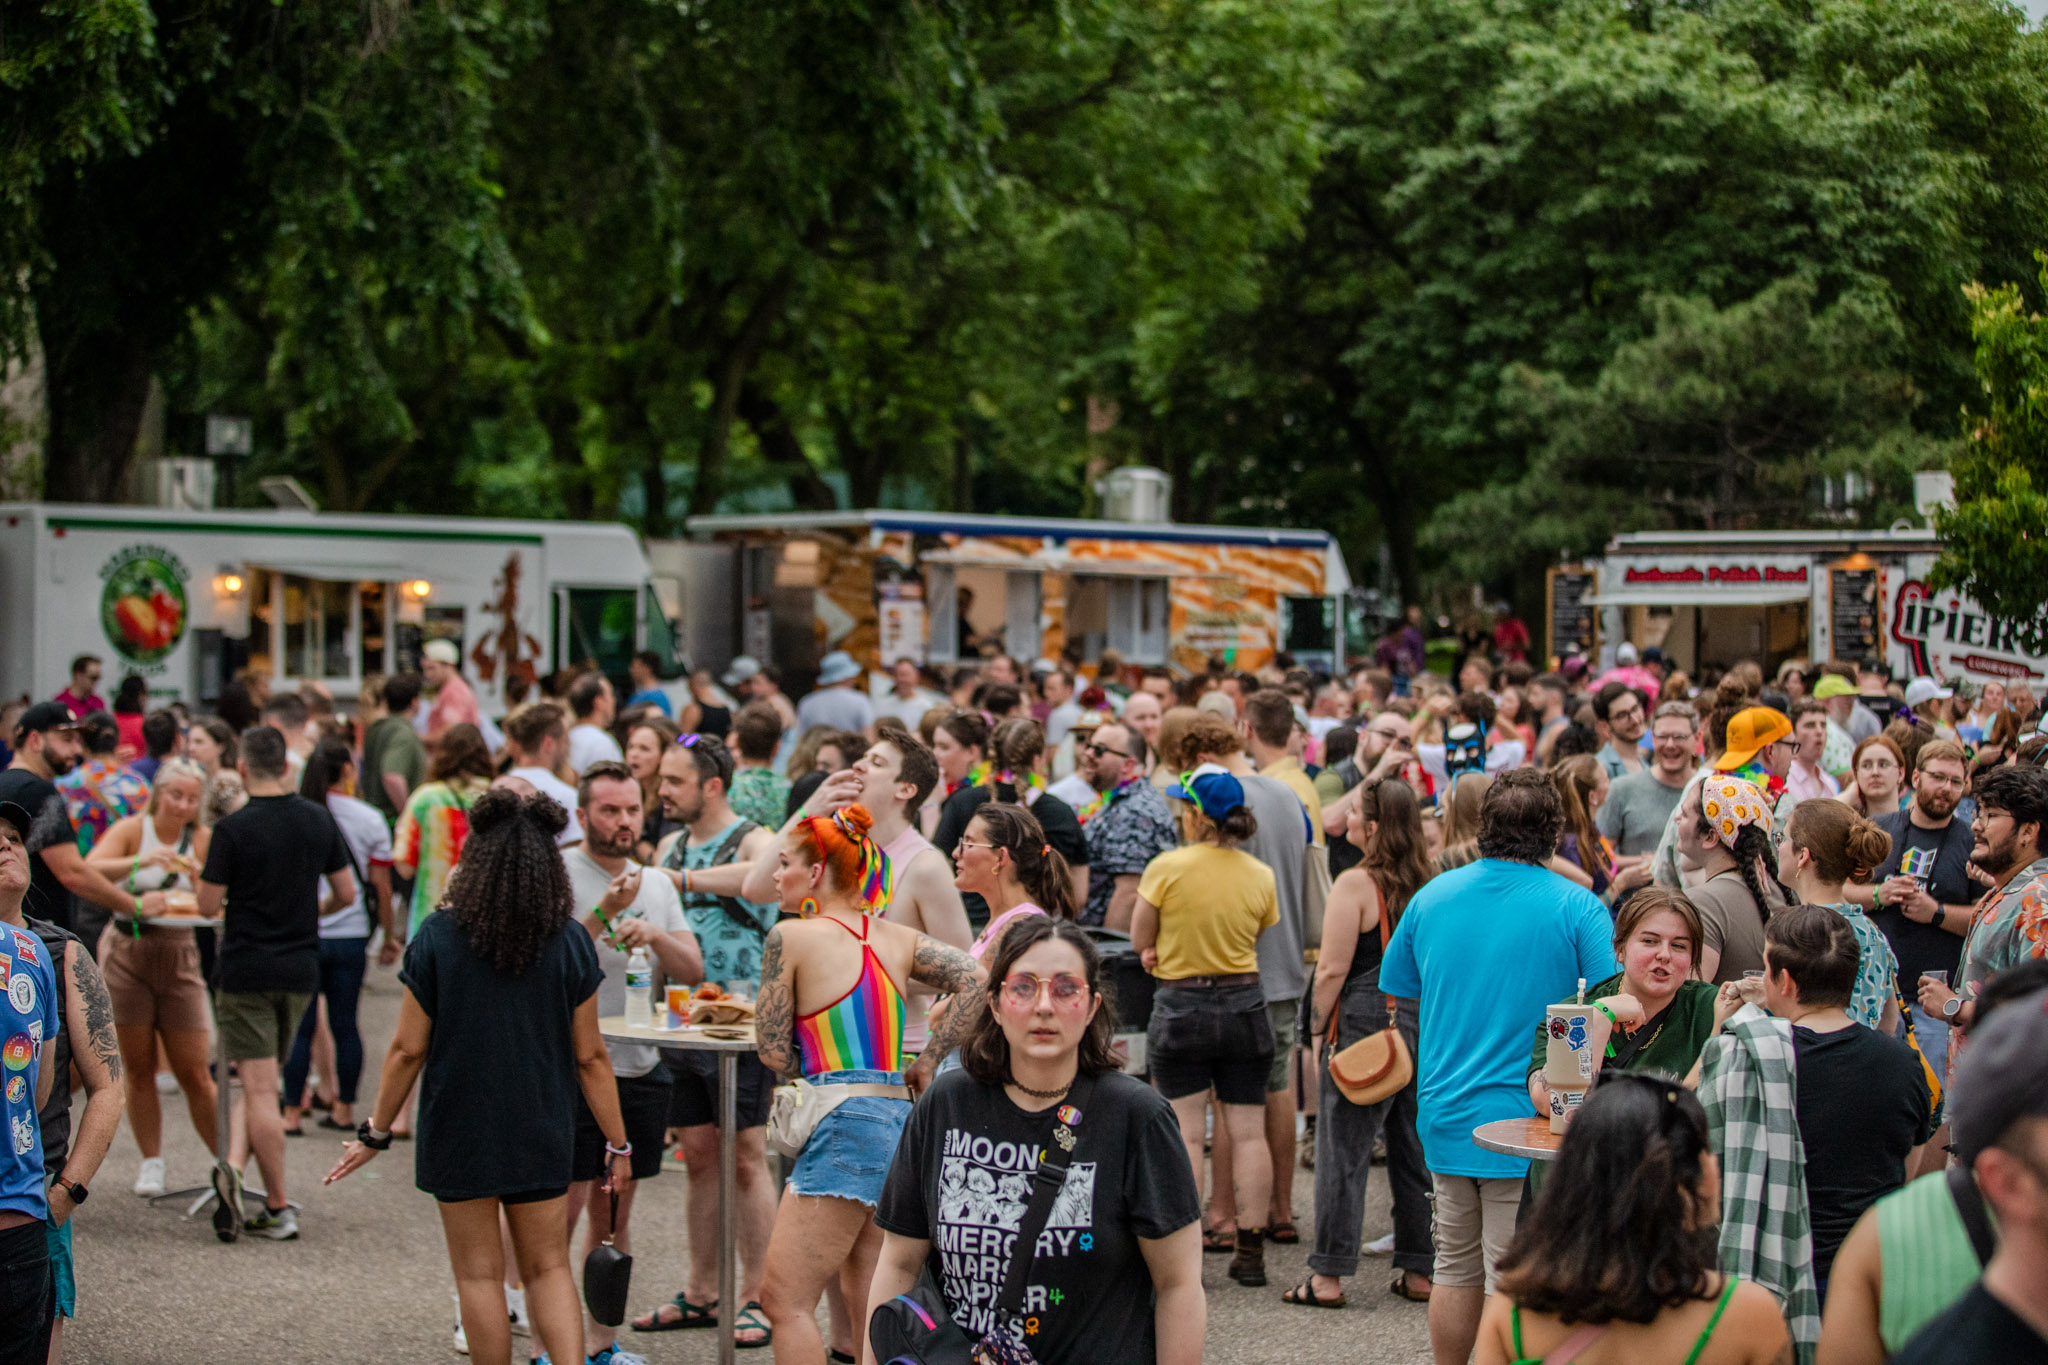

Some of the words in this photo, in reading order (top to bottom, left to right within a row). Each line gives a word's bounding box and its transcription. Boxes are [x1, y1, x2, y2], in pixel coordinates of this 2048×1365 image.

[951, 1128, 1040, 1171] MOON
[940, 1224, 1077, 1258] MERCRY
[946, 1276, 1048, 1315] JUPIR
